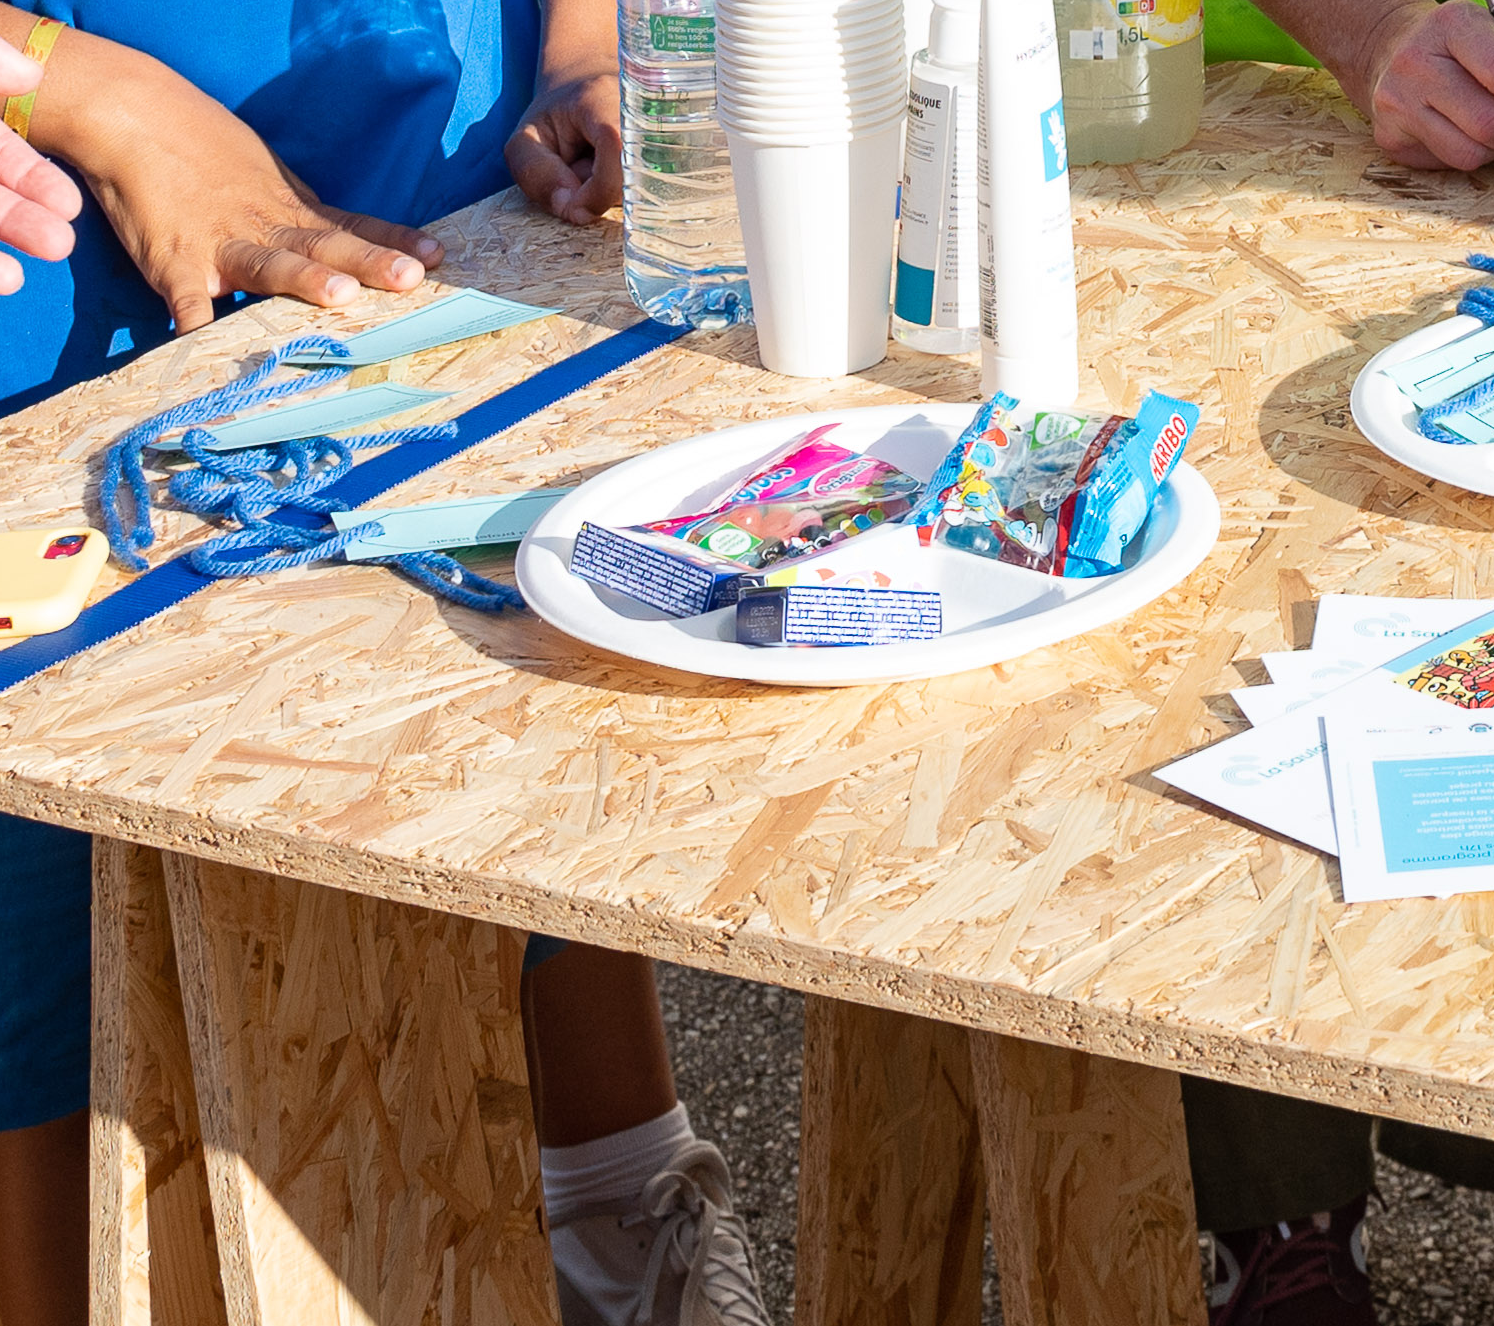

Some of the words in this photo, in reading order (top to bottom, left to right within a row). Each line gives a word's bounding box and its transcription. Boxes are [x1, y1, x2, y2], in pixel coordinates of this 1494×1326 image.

[1117, 25, 1149, 47] 1,5L
[1149, 412, 1187, 481] HARIBO
[818, 460, 874, 494] Original
[1459, 843, 1483, 852] 17h
